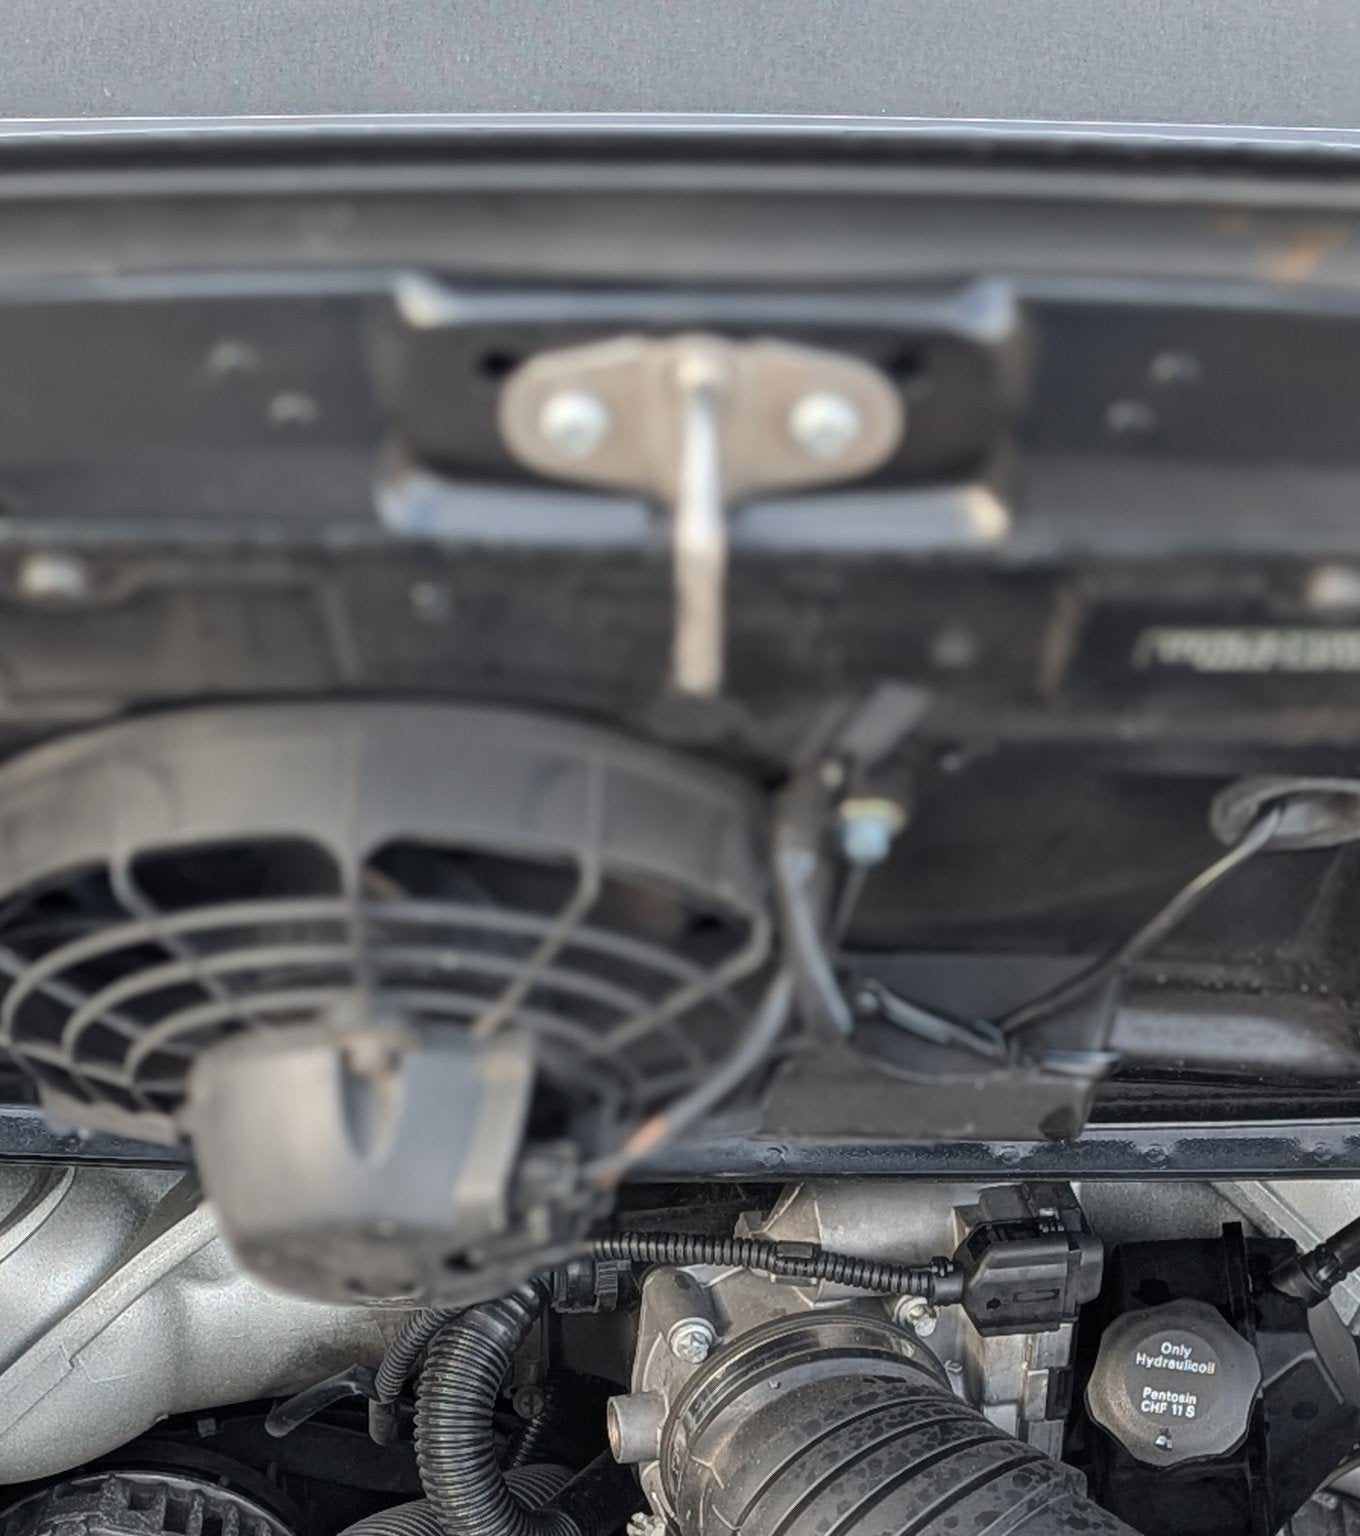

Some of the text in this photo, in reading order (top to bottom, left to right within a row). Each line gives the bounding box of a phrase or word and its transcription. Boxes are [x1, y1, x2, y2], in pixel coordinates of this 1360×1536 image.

[1161, 1341, 1192, 1358] Only
[1142, 1387, 1197, 1405] Pentosin
[1141, 1400, 1196, 1418] CHF 11 S
